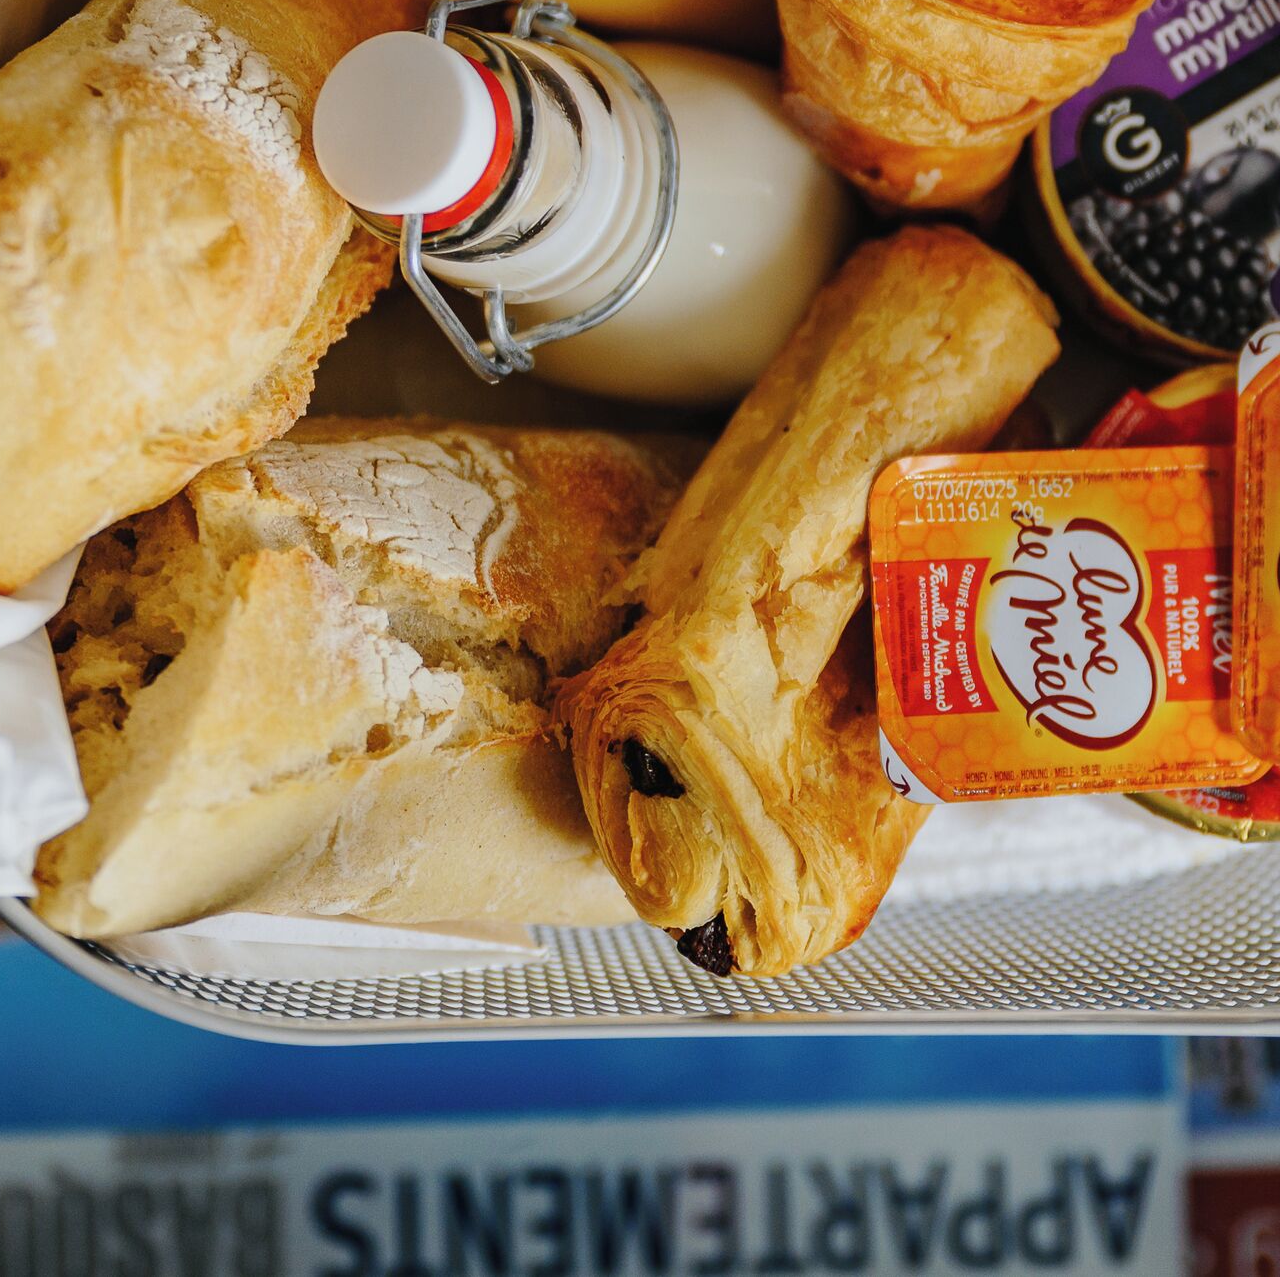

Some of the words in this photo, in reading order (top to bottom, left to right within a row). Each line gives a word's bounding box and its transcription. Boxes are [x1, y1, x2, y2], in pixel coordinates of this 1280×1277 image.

[1103, 114, 1162, 172] G
[912, 478, 1017, 501] 01/04/2025
[928, 562, 950, 631] Famille
[956, 563, 977, 609] CERTIFIÉ
[1163, 564, 1179, 595] PUR
[917, 575, 929, 641] APICULTEURS
[954, 609, 966, 631] PAR
[1069, 552, 1131, 693] lune
[1181, 596, 1200, 651] 100%
[921, 642, 931, 678] DEPUIS
[931, 632, 954, 712] Michaud
[955, 640, 976, 692] CERTIFIED
[968, 693, 982, 709] BY
[311, 1157, 1150, 1277] APPARTEMENTS
